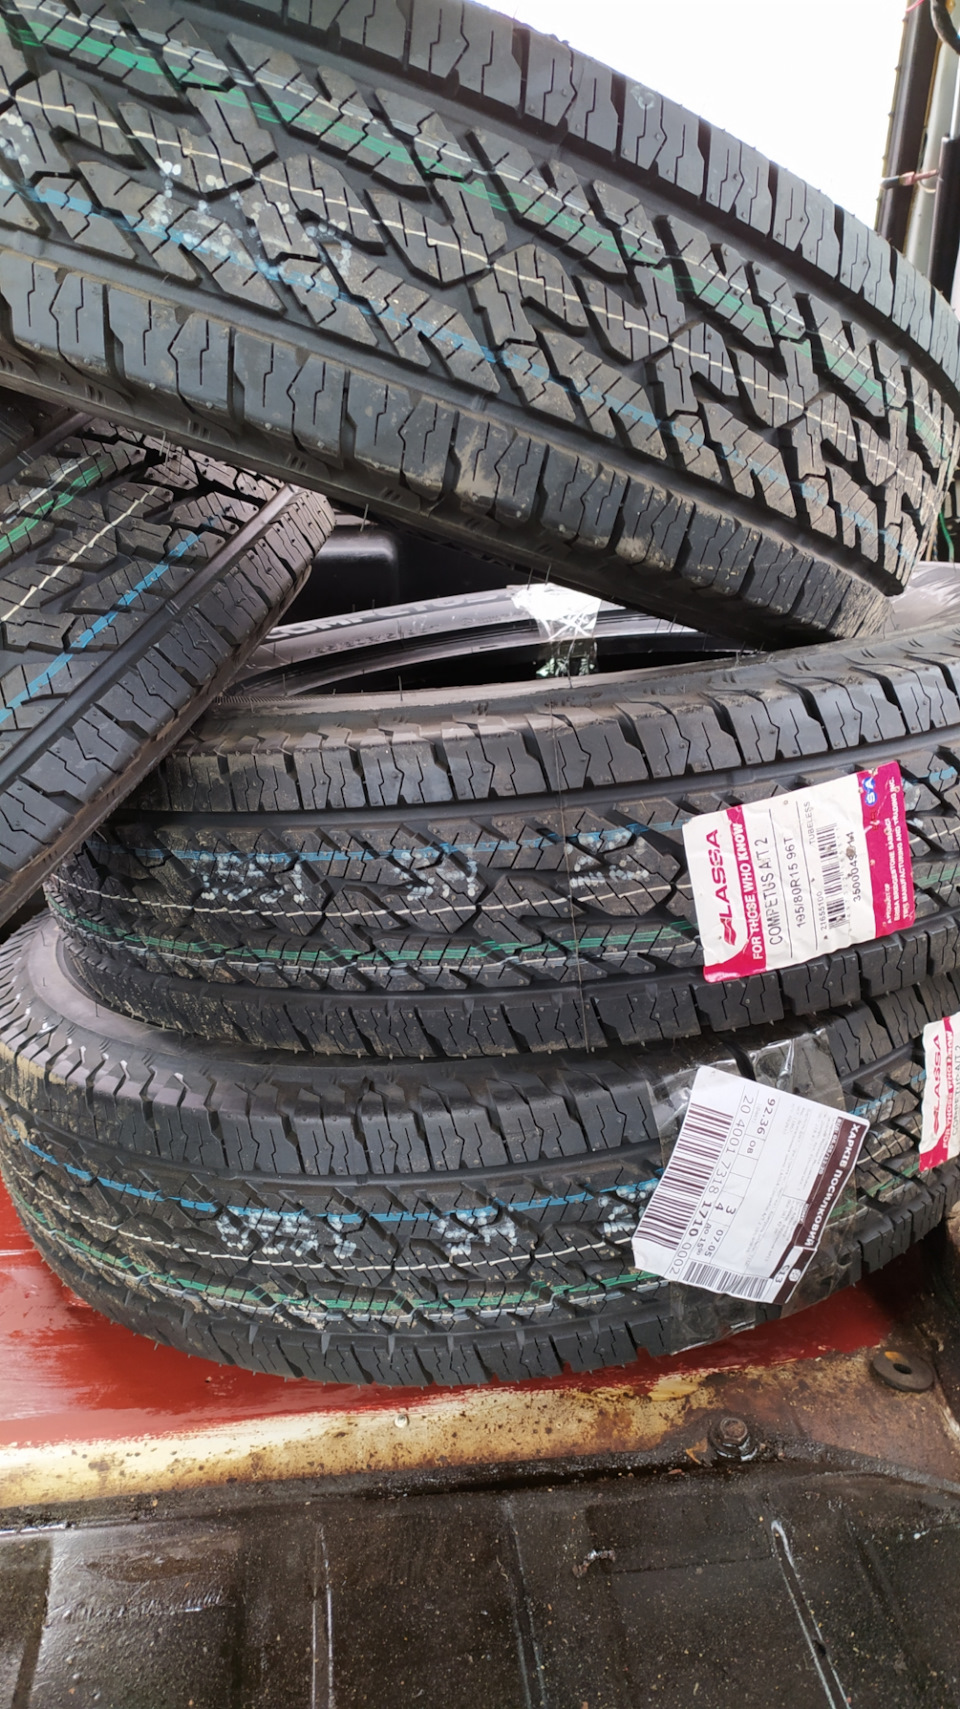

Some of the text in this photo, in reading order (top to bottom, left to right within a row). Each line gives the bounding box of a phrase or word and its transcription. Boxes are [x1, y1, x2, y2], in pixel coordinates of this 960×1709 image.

[754, 837, 768, 846] 2
[803, 801, 815, 844] TUBELESS
[706, 829, 732, 918] LASSA
[732, 823, 763, 960] FOR THOSE WHO KNOW
[783, 837, 806, 928] 195/80R15 96T
[760, 873, 783, 945] COMPETUS
[757, 1098, 776, 1135] 92.36
[839, 1123, 861, 1168] ХАРКІВ
[669, 1095, 754, 1275] 20 4001 7318 1710 0002
[715, 1202, 723, 1211] 4
[804, 1169, 843, 1246] ПОСИЛКОВИЙ
[726, 1205, 736, 1215] 3
[704, 1229, 724, 1257] 07.05
